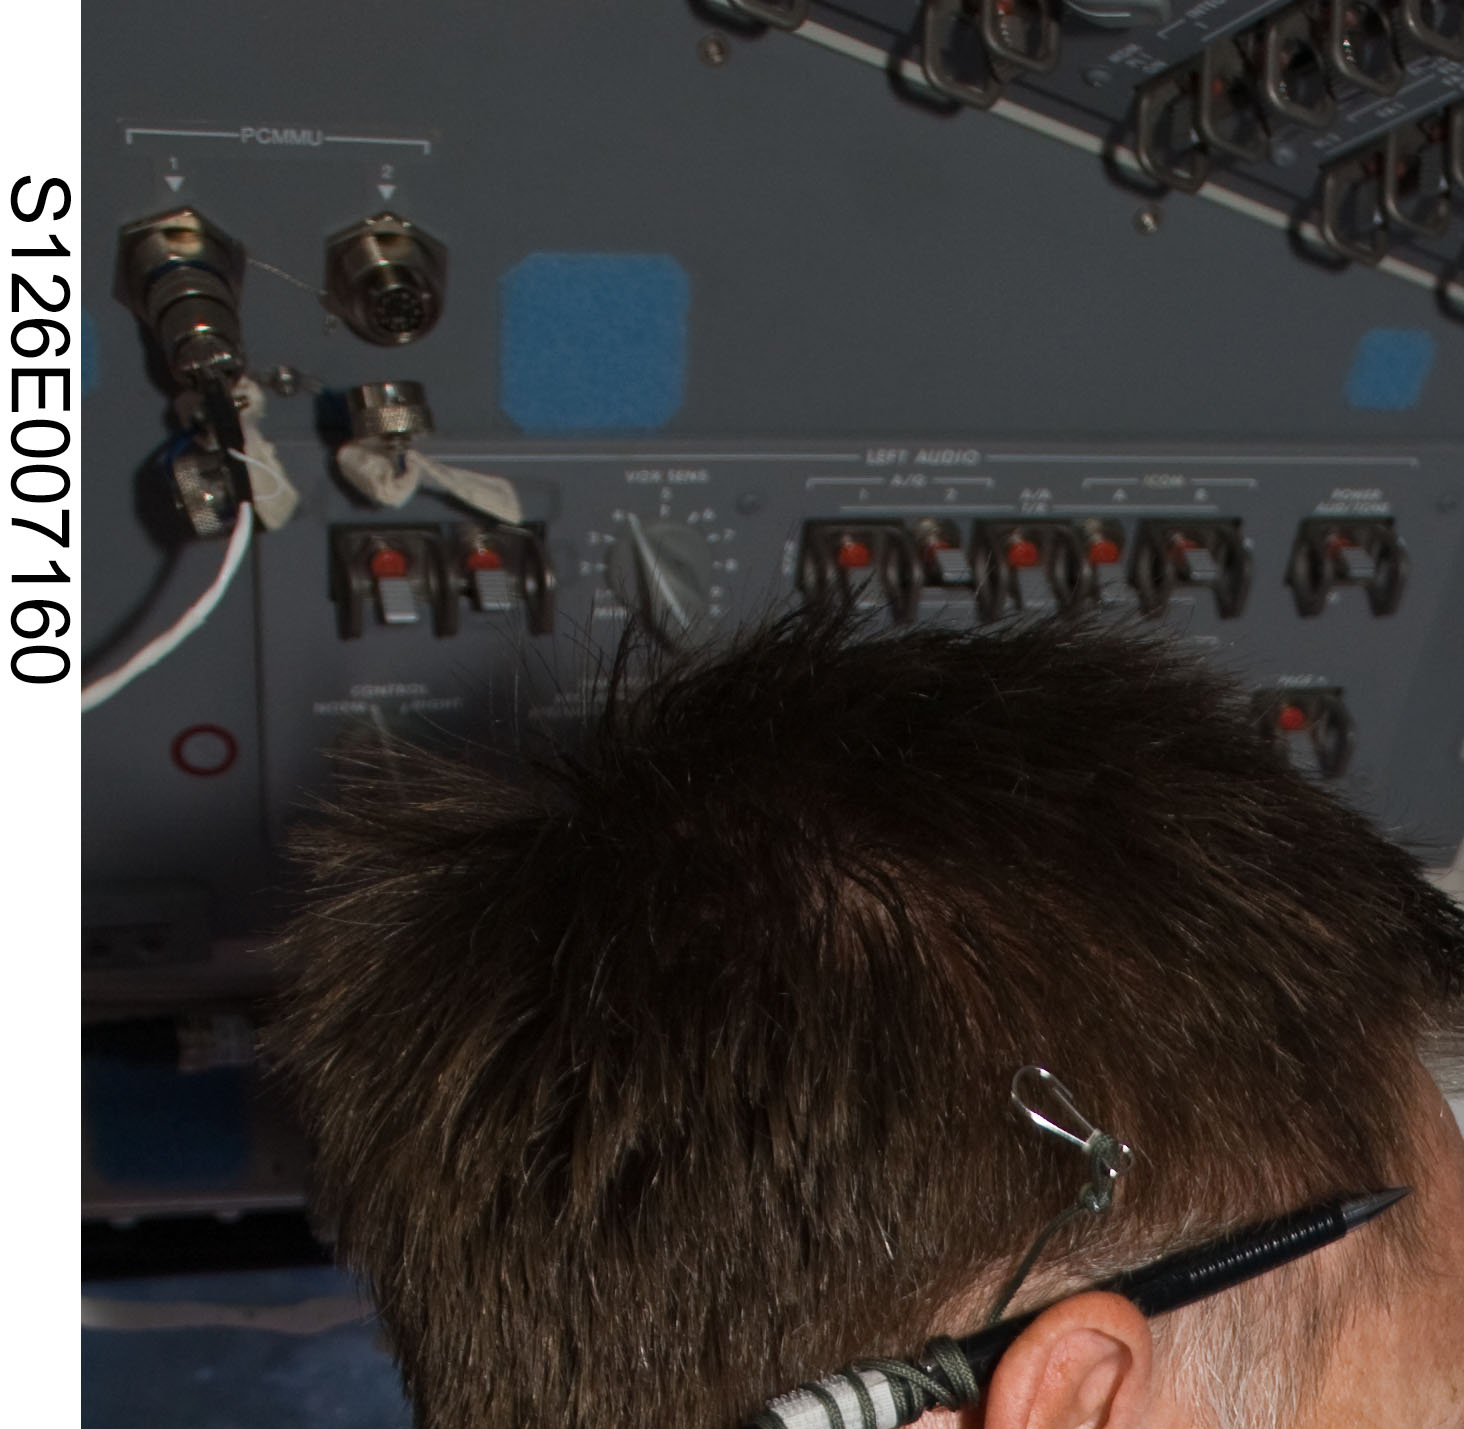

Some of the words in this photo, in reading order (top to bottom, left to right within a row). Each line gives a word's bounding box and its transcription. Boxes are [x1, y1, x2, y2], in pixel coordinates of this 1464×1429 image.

[241, 127, 323, 147] PCMMU
[169, 157, 179, 171] 1
[381, 165, 393, 179] 2
[866, 449, 909, 466] LEFT
[915, 448, 981, 467] AUDIO
